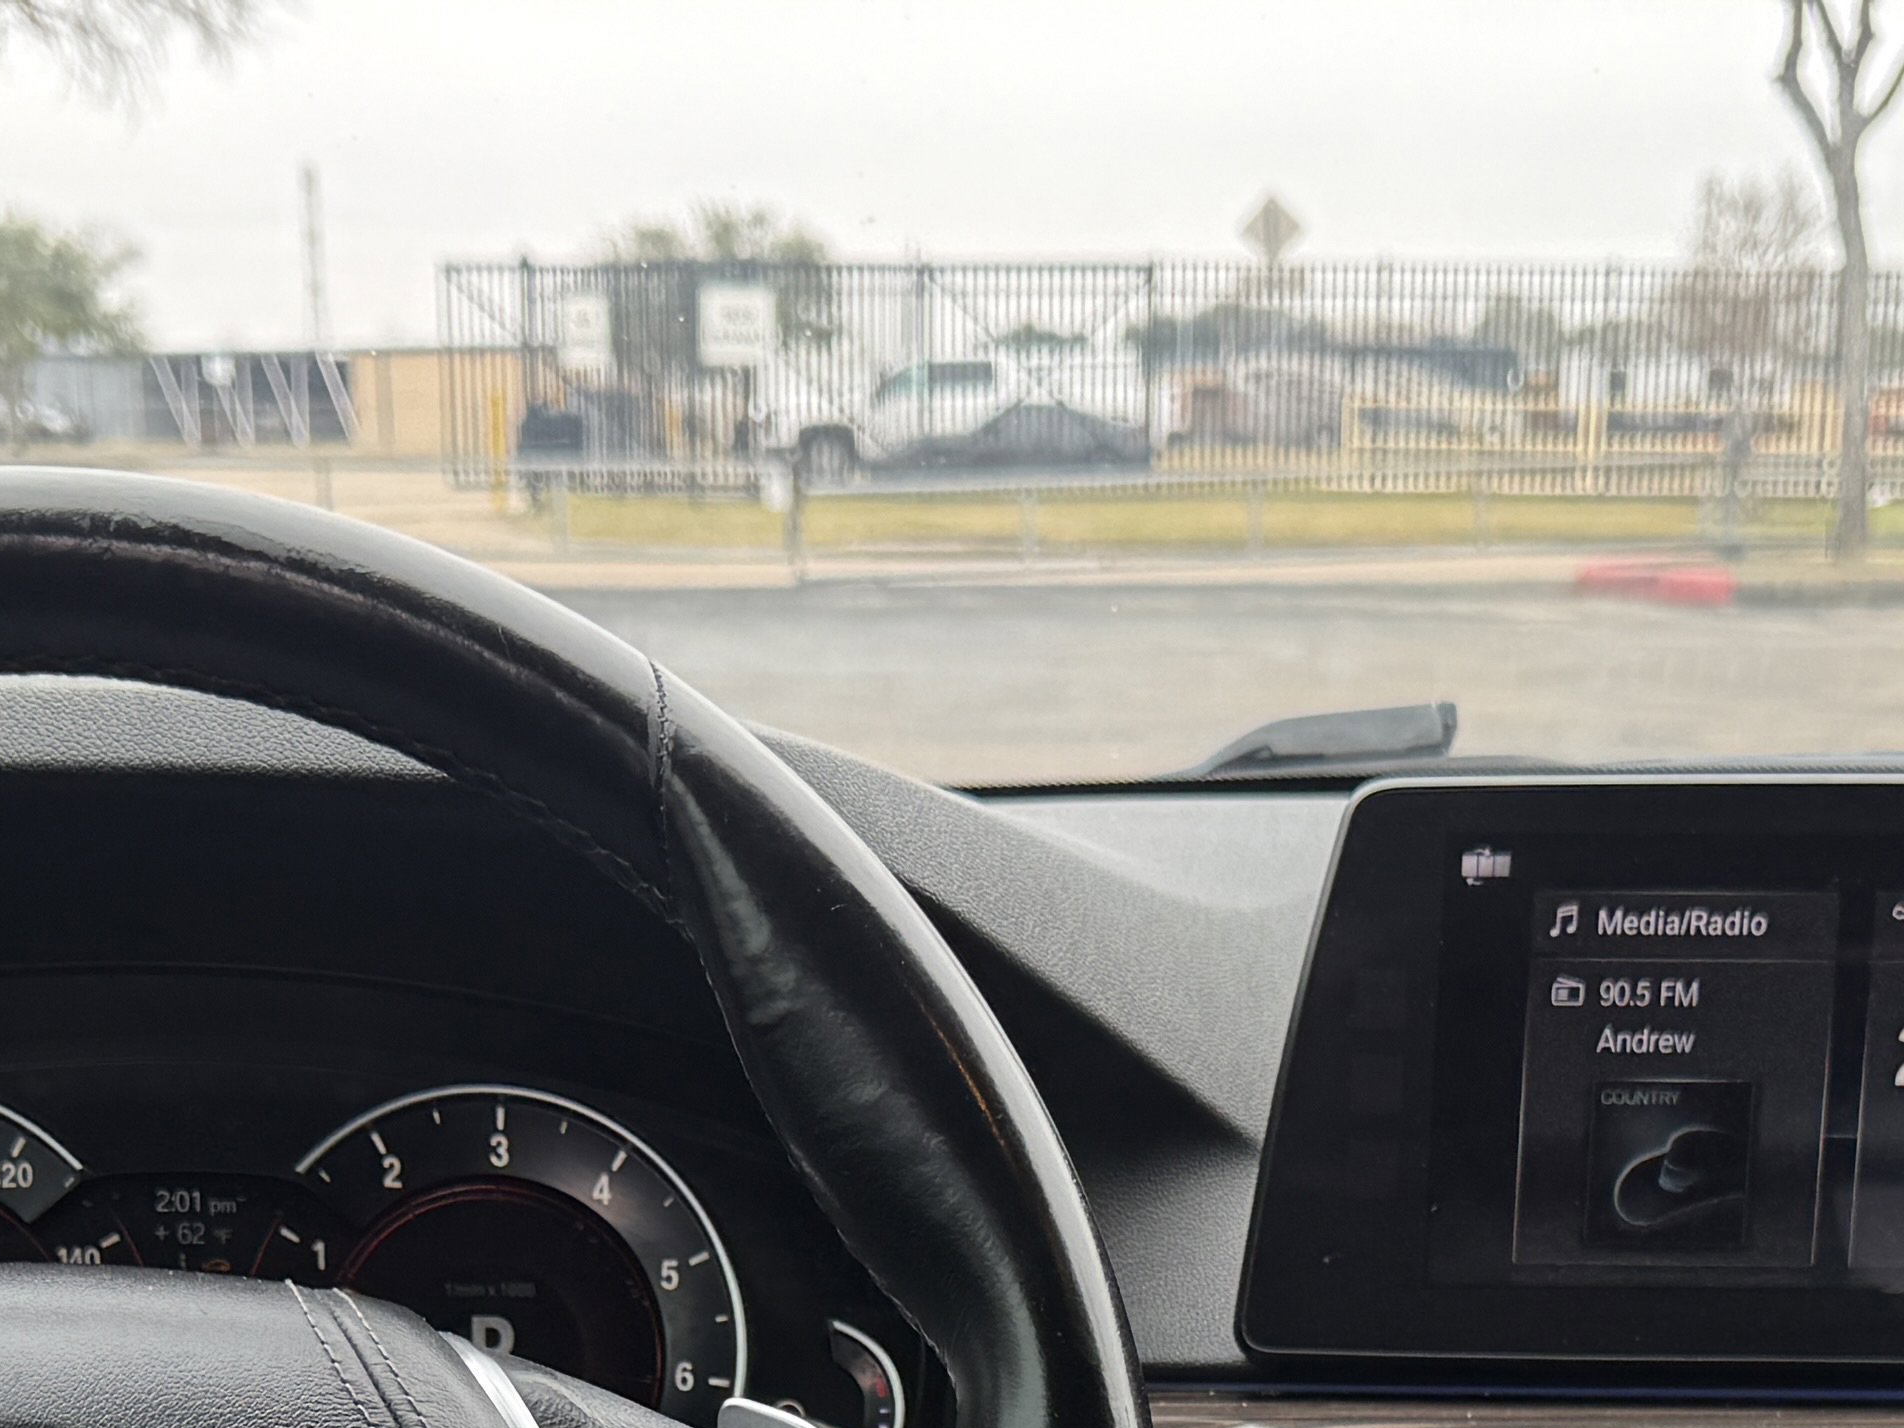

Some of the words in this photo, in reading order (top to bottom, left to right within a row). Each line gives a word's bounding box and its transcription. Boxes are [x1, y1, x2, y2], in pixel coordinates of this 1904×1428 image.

[1597, 905, 1770, 937] Media/Radio
[1599, 979, 1650, 1008] 90.5
[1660, 978, 1700, 1007] FM
[1596, 1024, 1696, 1054] Andrew
[1601, 1089, 1681, 1106] COUNTRY
[489, 1133, 510, 1167] 3
[381, 1155, 403, 1189] 2
[154, 1190, 202, 1213] 2:01
[208, 1198, 238, 1216] pm
[592, 1172, 612, 1205] 4
[177, 1224, 206, 1244] 62
[312, 1239, 326, 1271] 1
[660, 1258, 680, 1291] 5
[674, 1360, 693, 1392] 6
